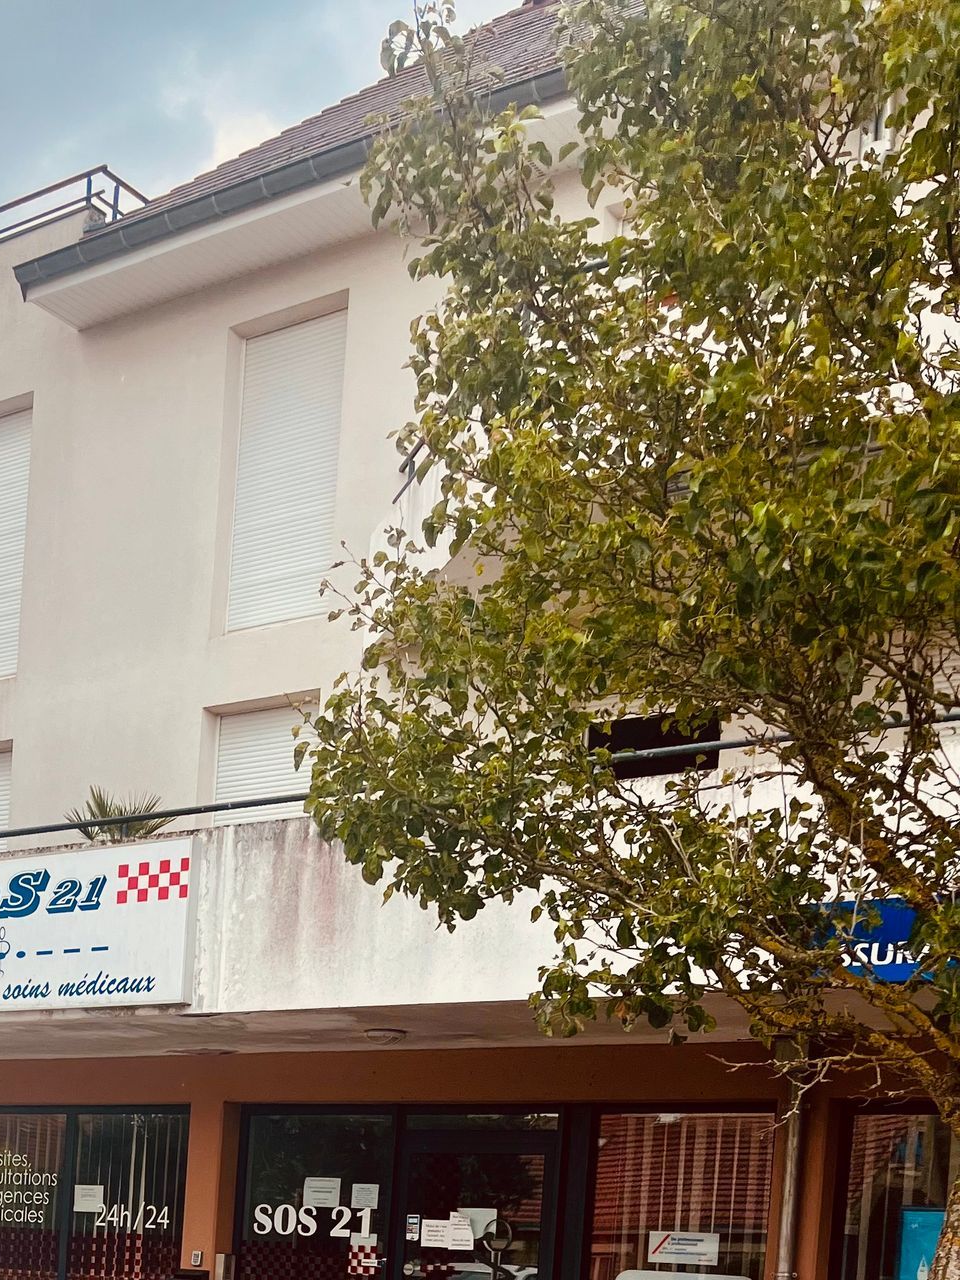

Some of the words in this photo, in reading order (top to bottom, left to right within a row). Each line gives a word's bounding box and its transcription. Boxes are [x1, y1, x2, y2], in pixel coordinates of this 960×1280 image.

[47, 875, 107, 914] 21
[3, 979, 52, 999] soins
[58, 972, 157, 997] médicaux
[95, 1202, 170, 1230] 24h/24
[253, 1203, 317, 1236] SOS
[329, 1206, 372, 1238] 21
